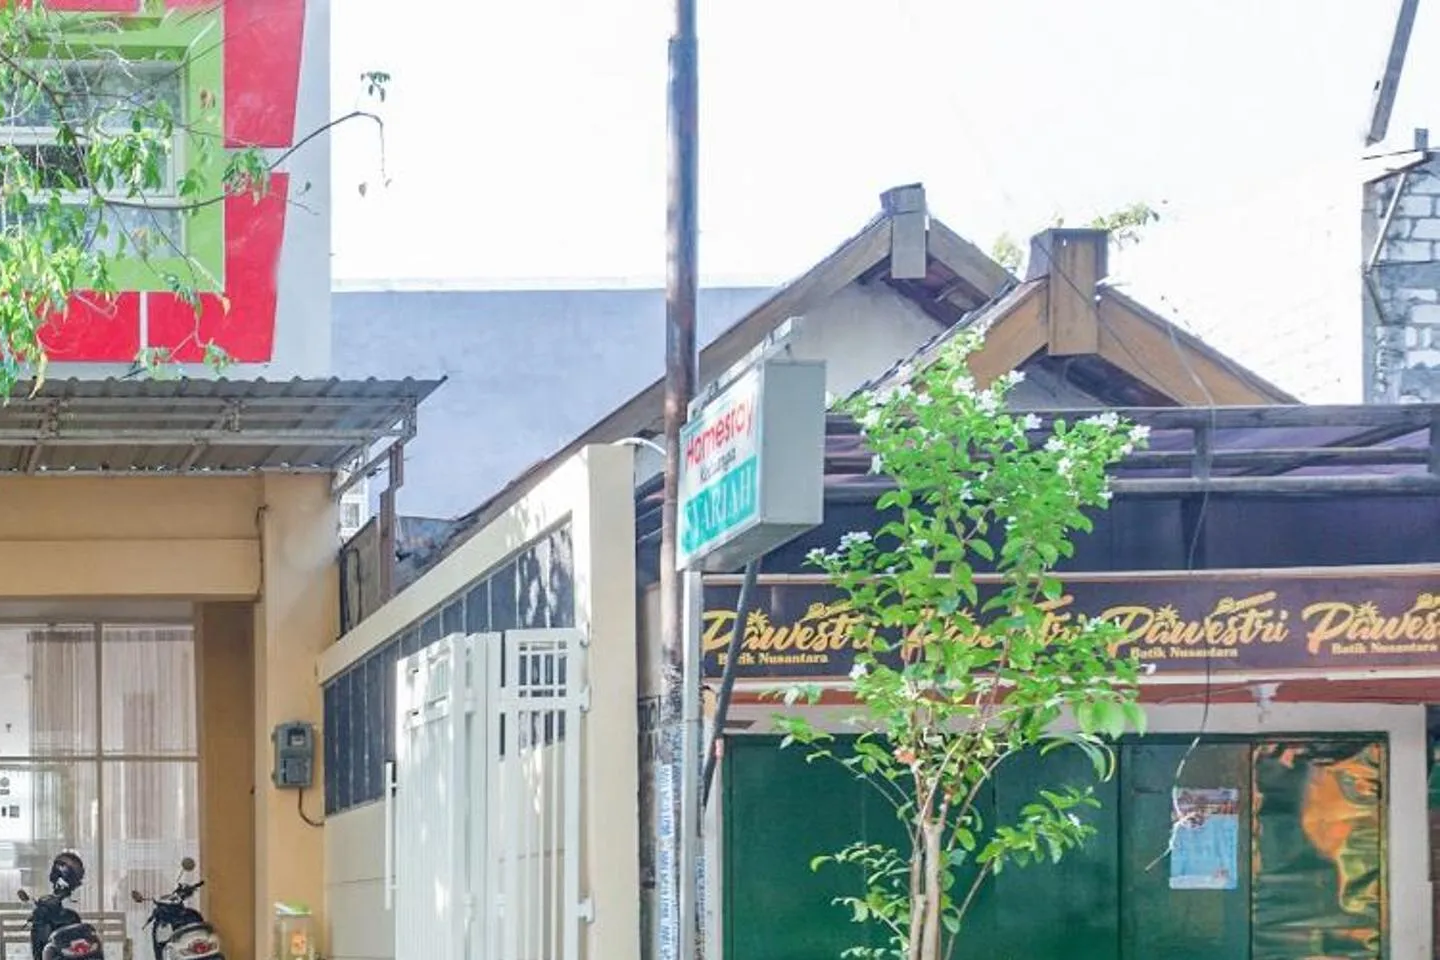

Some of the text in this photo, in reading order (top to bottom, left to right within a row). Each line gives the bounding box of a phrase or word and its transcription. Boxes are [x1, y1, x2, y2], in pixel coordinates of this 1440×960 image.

[1100, 591, 1289, 658] Pawestri
[1301, 592, 1440, 655] Pawes
[760, 652, 829, 664] Nusantara
[1130, 646, 1239, 659] Batik Nusantara
